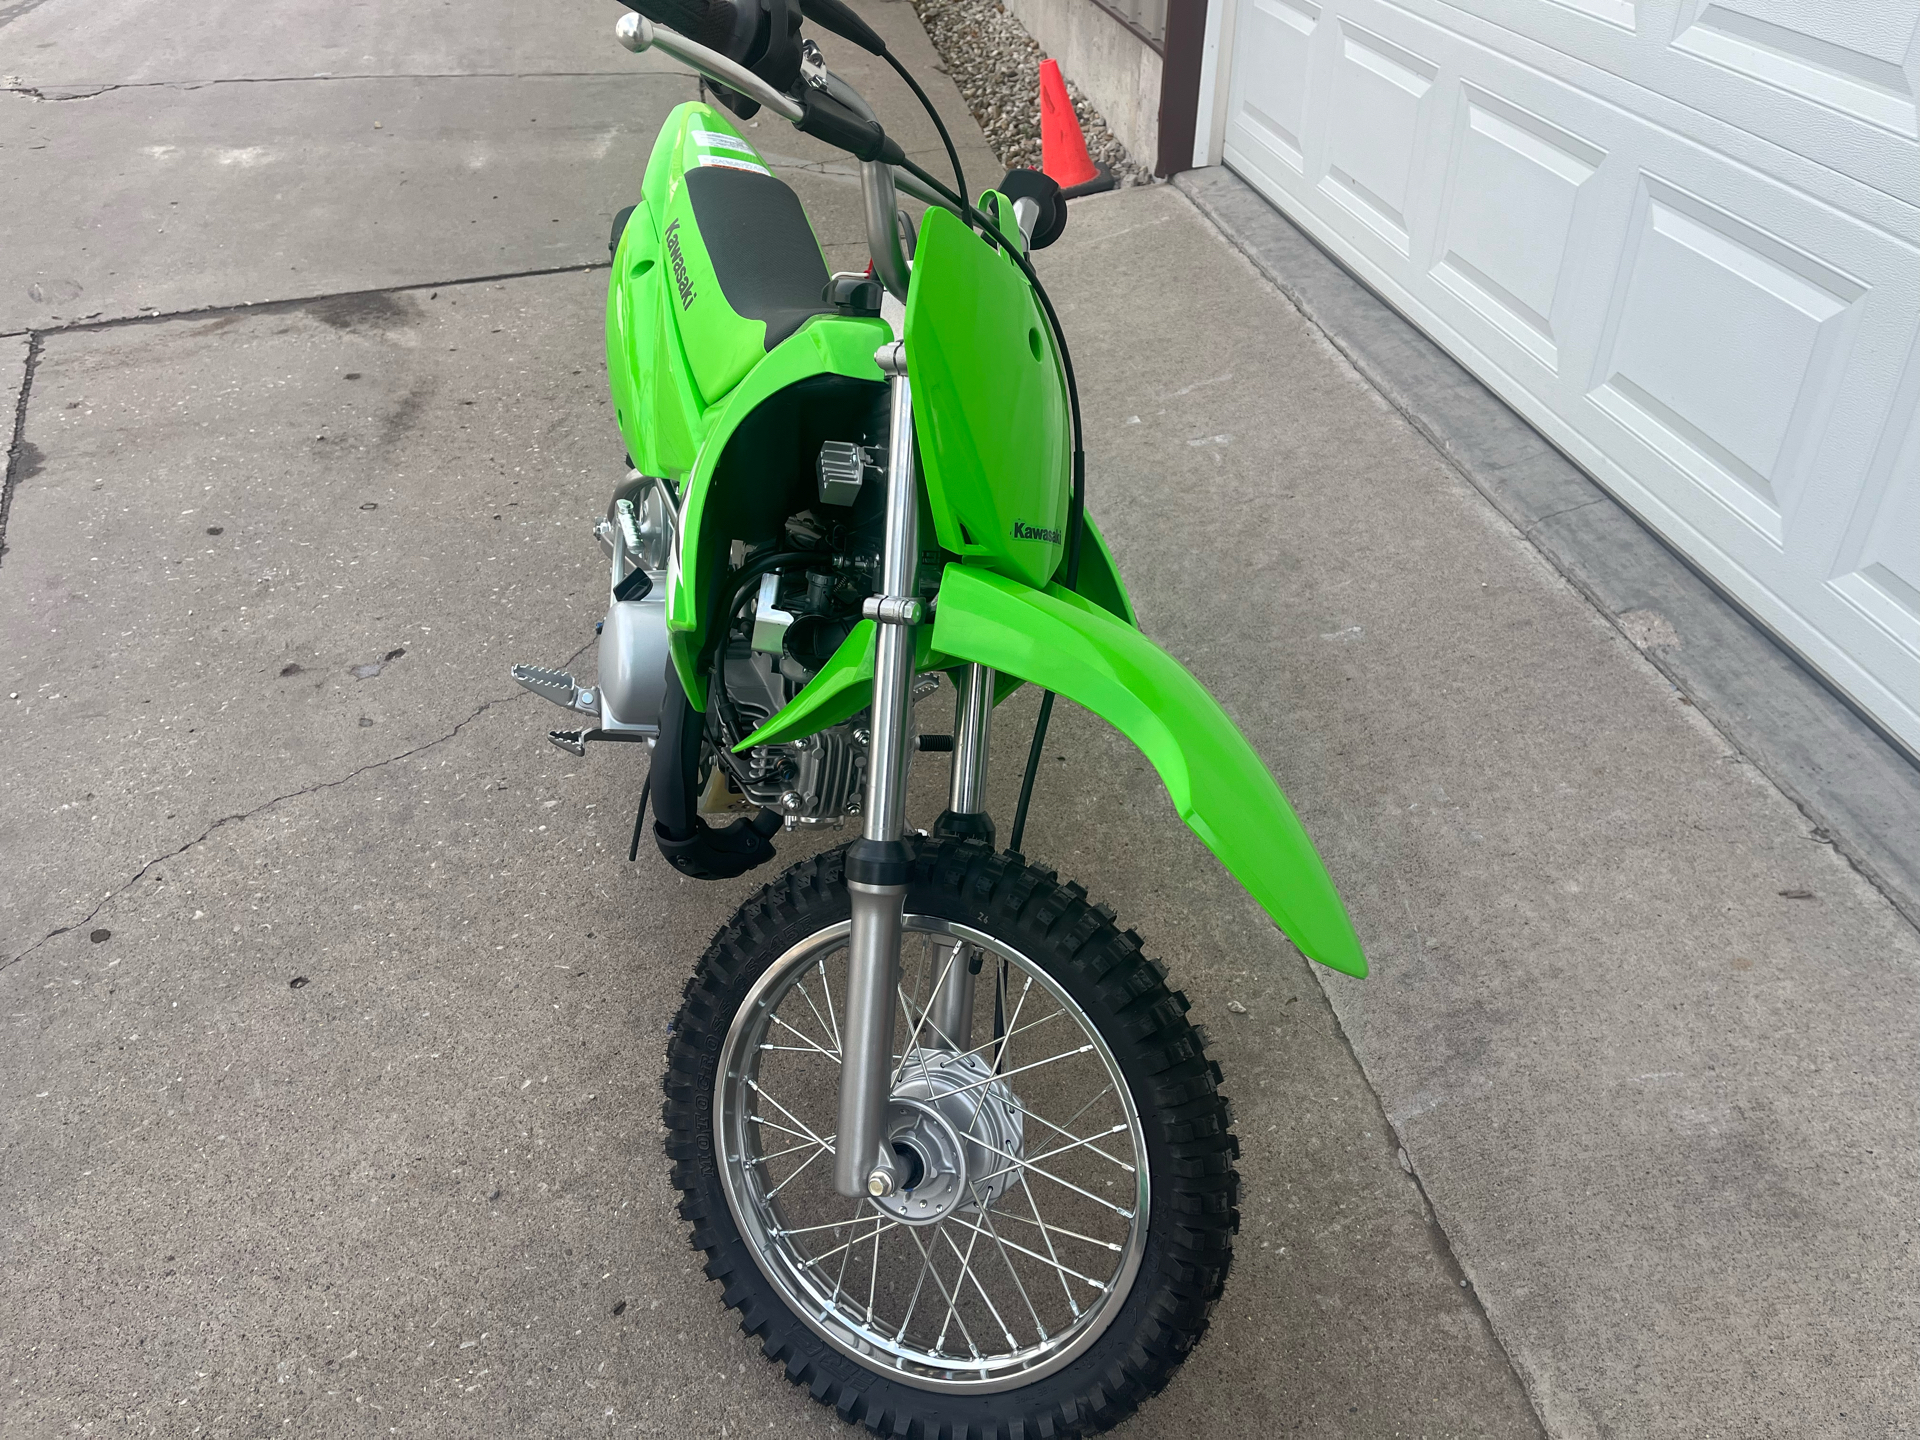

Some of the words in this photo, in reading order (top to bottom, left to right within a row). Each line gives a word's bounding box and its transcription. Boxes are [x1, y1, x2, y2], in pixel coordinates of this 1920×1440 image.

[665, 217, 697, 311] Kawasaki
[1014, 522, 1062, 545] Kawasaki
[695, 997, 733, 1178] MOTOCROSS
